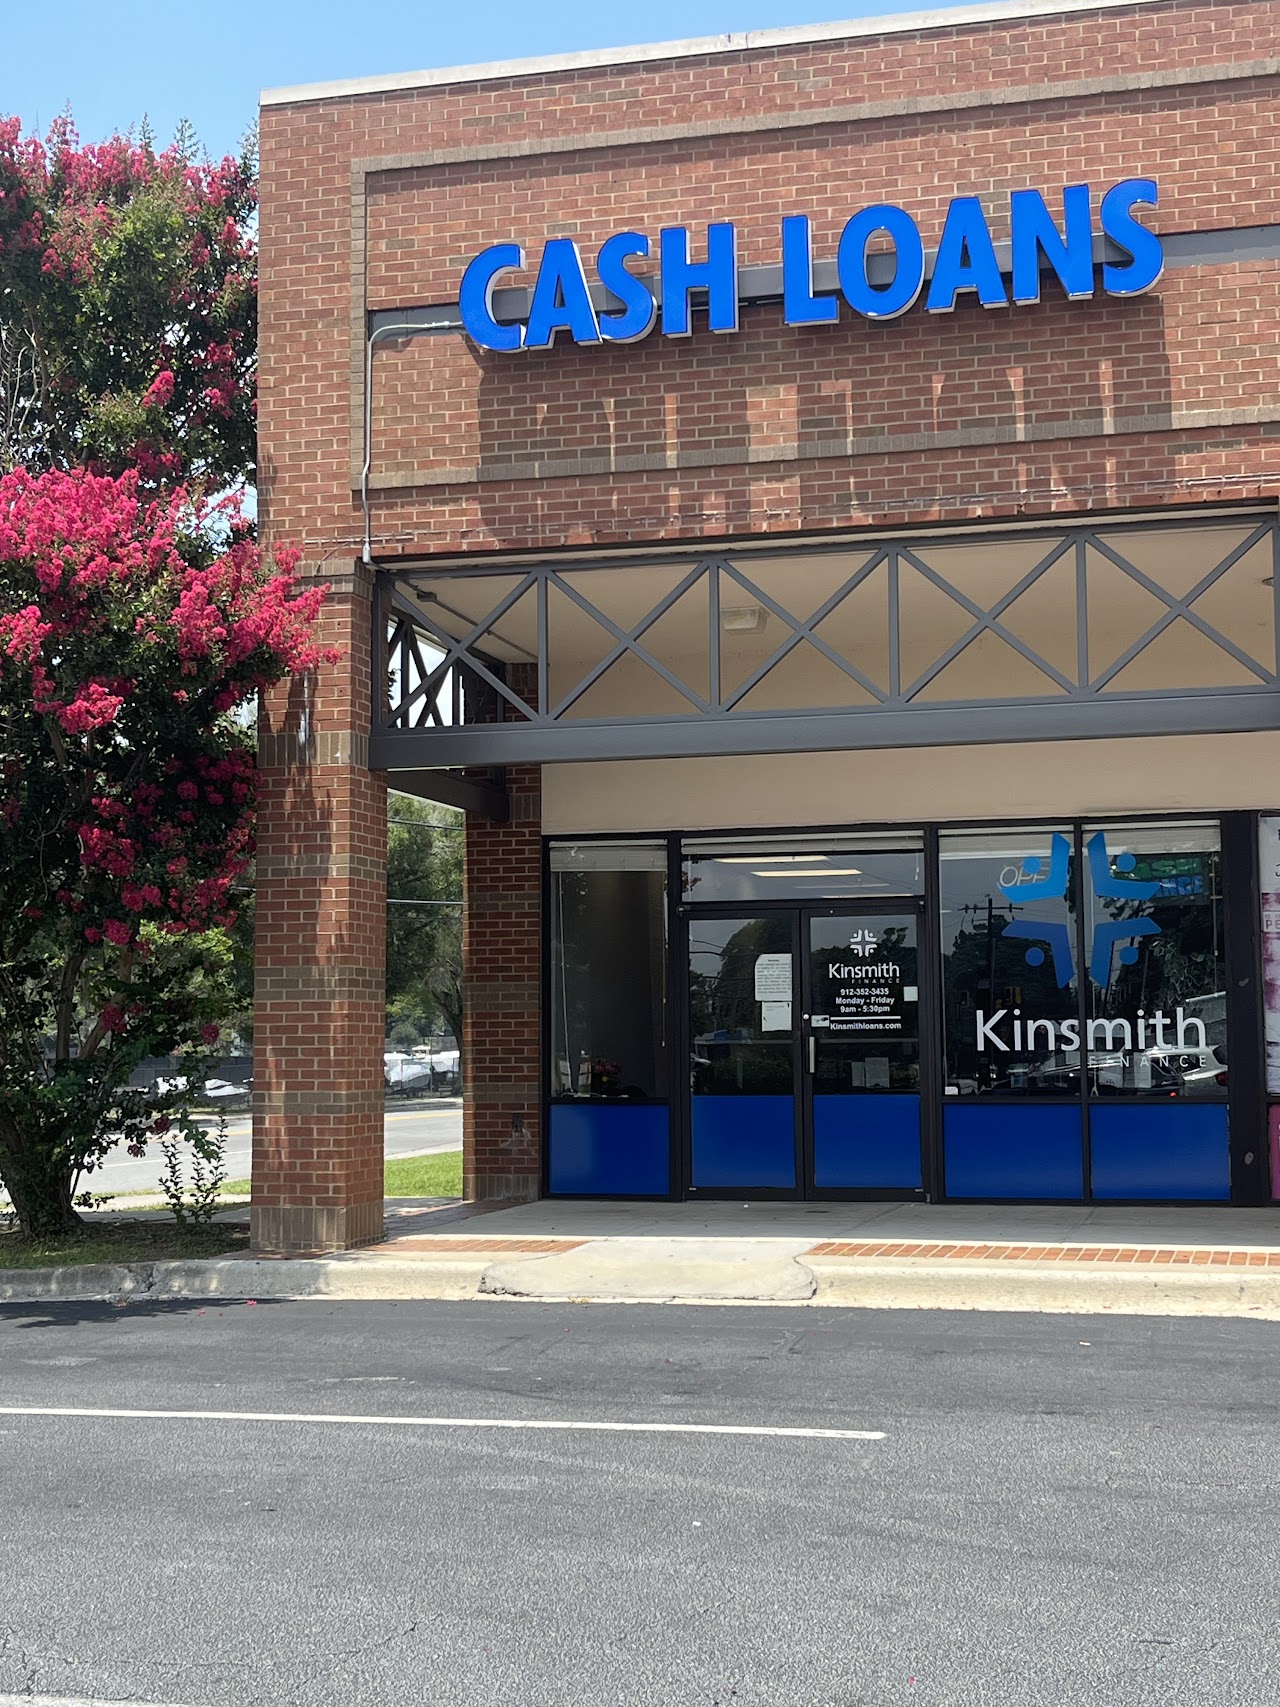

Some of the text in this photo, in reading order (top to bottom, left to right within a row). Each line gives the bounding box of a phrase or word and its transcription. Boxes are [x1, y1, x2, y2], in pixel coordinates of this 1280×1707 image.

[459, 178, 1165, 353] CASH LOANS
[828, 962, 900, 978] Kinsmith
[840, 988, 889, 996] 912-352-3435
[835, 997, 865, 1005] Monday
[870, 997, 895, 1005] Friday
[862, 1005, 891, 1013] 5:30pm
[830, 1022, 901, 1030] Kinsmithloans.com
[976, 1007, 1206, 1051] Kinsmith
[1089, 1055, 1207, 1067] FINANCE
